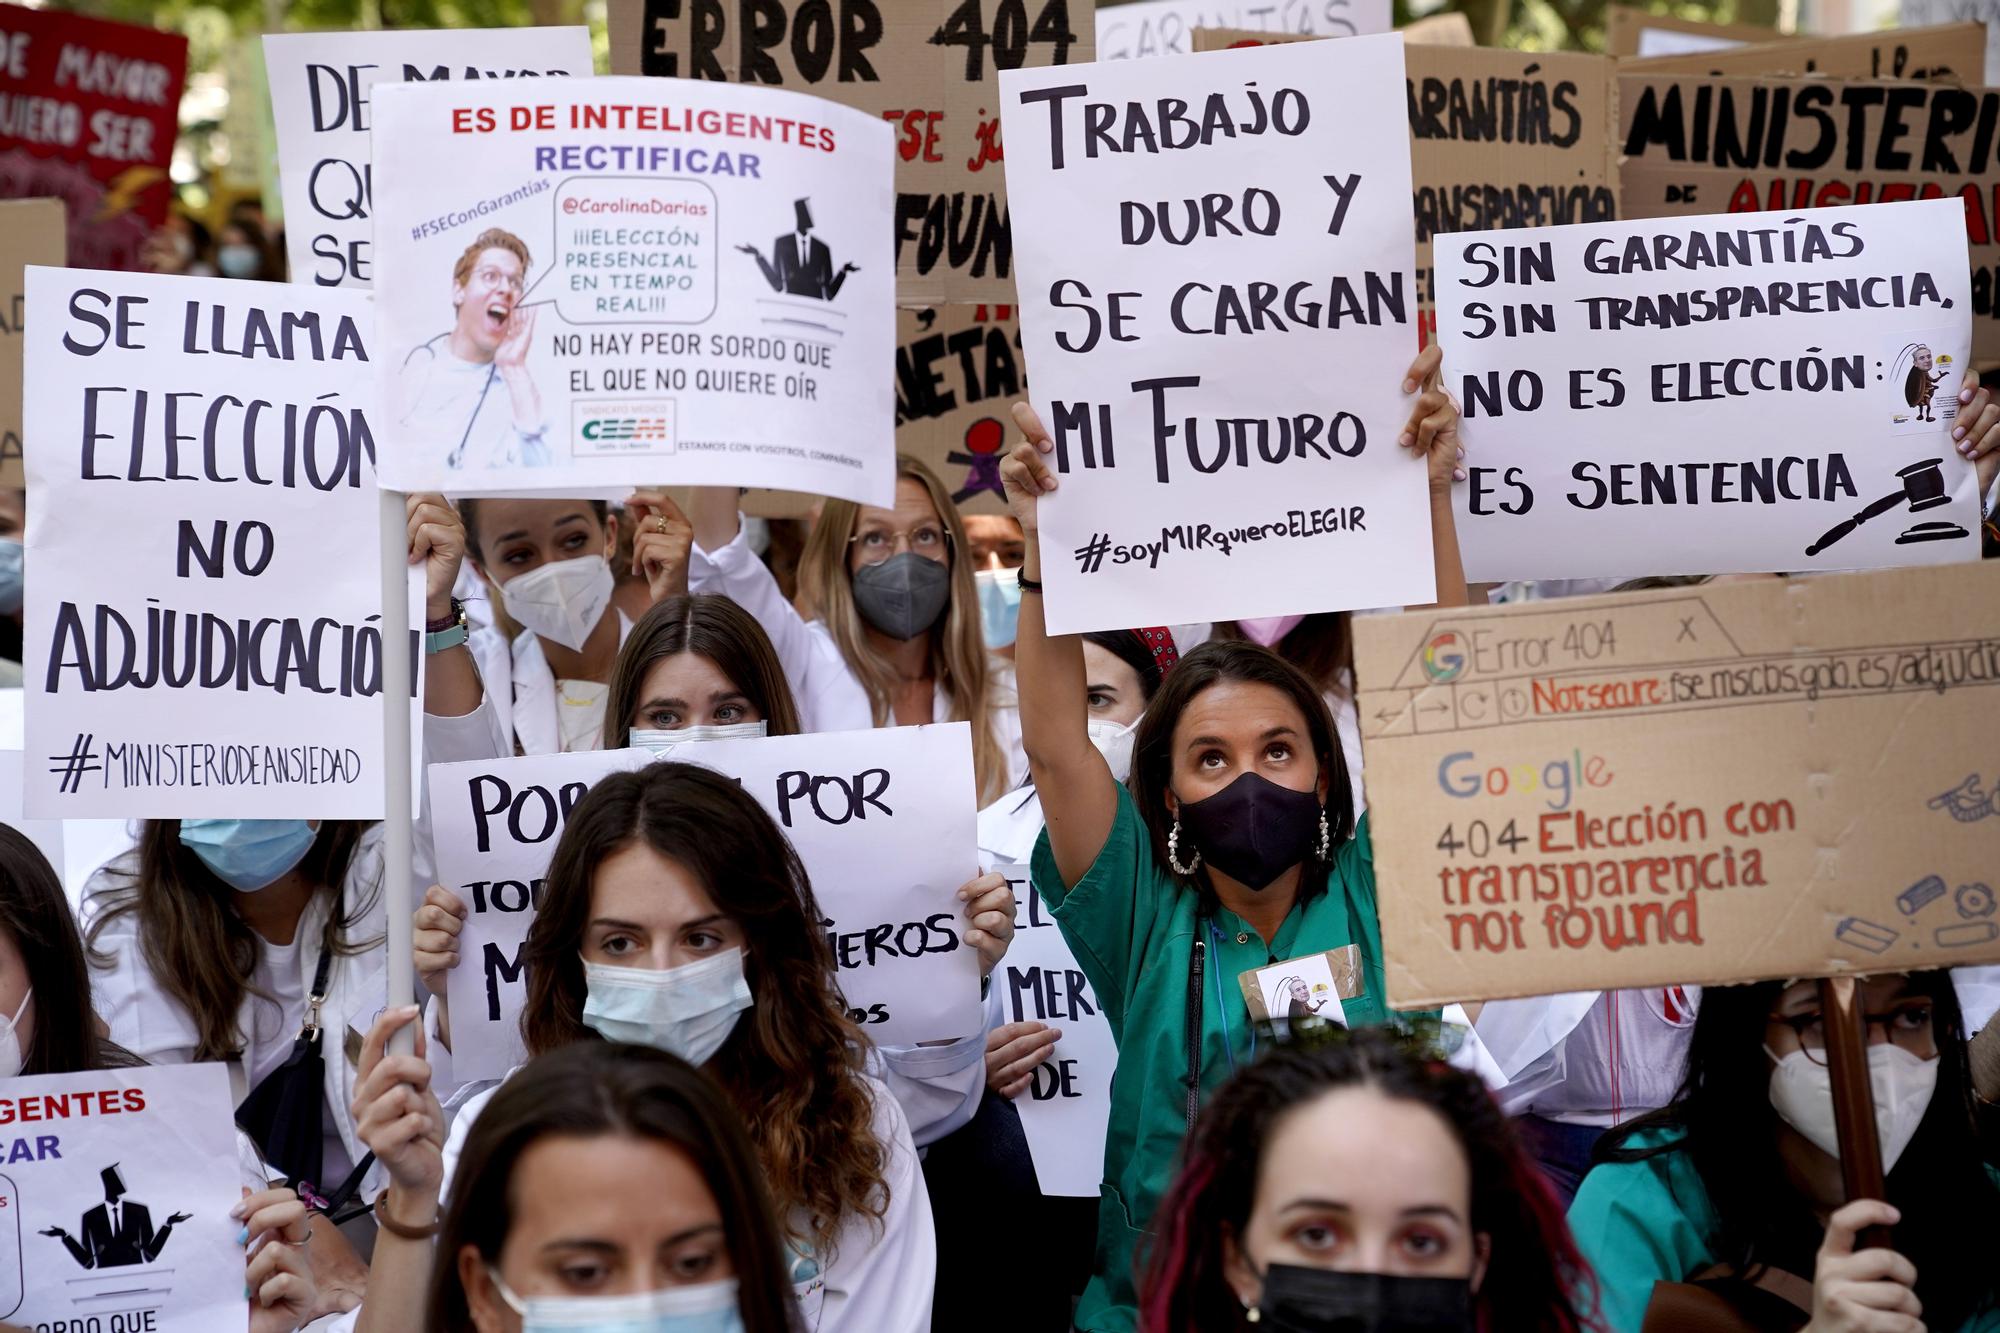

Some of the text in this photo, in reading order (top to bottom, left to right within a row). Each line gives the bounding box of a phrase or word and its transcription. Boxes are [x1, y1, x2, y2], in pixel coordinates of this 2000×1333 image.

[641, 0, 1077, 84] ERROR 404
[55, 43, 171, 107] MAYOR
[306, 64, 379, 132] DE
[87, 109, 155, 161] SER
[452, 104, 837, 152] ES DE INTELIGENTES
[1020, 82, 1310, 170] TRABAJO
[1623, 83, 2000, 174] MINISTERI
[535, 145, 761, 178] RECTIFICAR
[411, 177, 551, 241] #FSEConGarantías
[563, 197, 708, 216] @CarolinaDarias
[1120, 173, 1362, 245] DURO Y
[1665, 185, 1697, 203] DE
[566, 252, 698, 269] PRESENCIAL
[1459, 241, 1555, 288] SIN
[1584, 217, 1865, 275] GARANTÍAS
[570, 274, 693, 291] EN TIEMPO
[596, 296, 666, 312] REAL!!!
[1050, 279, 1142, 353] SE
[1171, 271, 1407, 335] CARGAN
[1462, 301, 1555, 340] SIN
[1575, 271, 1954, 330] TRANSPARENCIA,
[63, 288, 369, 362] SE LLAMA
[553, 333, 832, 369] NO HAY PEOR SORDO QUE
[570, 369, 818, 401] EL QUE NO QUIERE OÍR
[1463, 370, 1543, 418] NO
[1568, 367, 1625, 410] ES
[81, 387, 377, 491] ELECCIÓN
[582, 418, 666, 440] CESM
[679, 441, 727, 451] ESTAMOS
[730, 443, 751, 453] CON
[1051, 376, 1367, 483] MI FUTURO
[1468, 453, 1859, 516] ES SENTENCIA
[177, 520, 274, 578] NO
[1075, 506, 1366, 575] #soyMIRquieroELEGIR
[46, 598, 420, 698] ADJUDICACIÓ
[1472, 629, 1553, 674] Error
[1562, 619, 1616, 661] 404
[49, 733, 361, 793] #MINISTERIODEANSIEDAD
[1438, 749, 1614, 809] Google
[776, 768, 893, 827] POR
[1437, 799, 1796, 858] 404 Elección con
[1440, 845, 1769, 908] transparencia
[1445, 893, 1704, 953] not found
[1007, 966, 1104, 1022] MER
[1030, 1060, 1083, 1101] DE
[0, 1134, 62, 1165] AR
[111, 1310, 157, 1333] QUE
